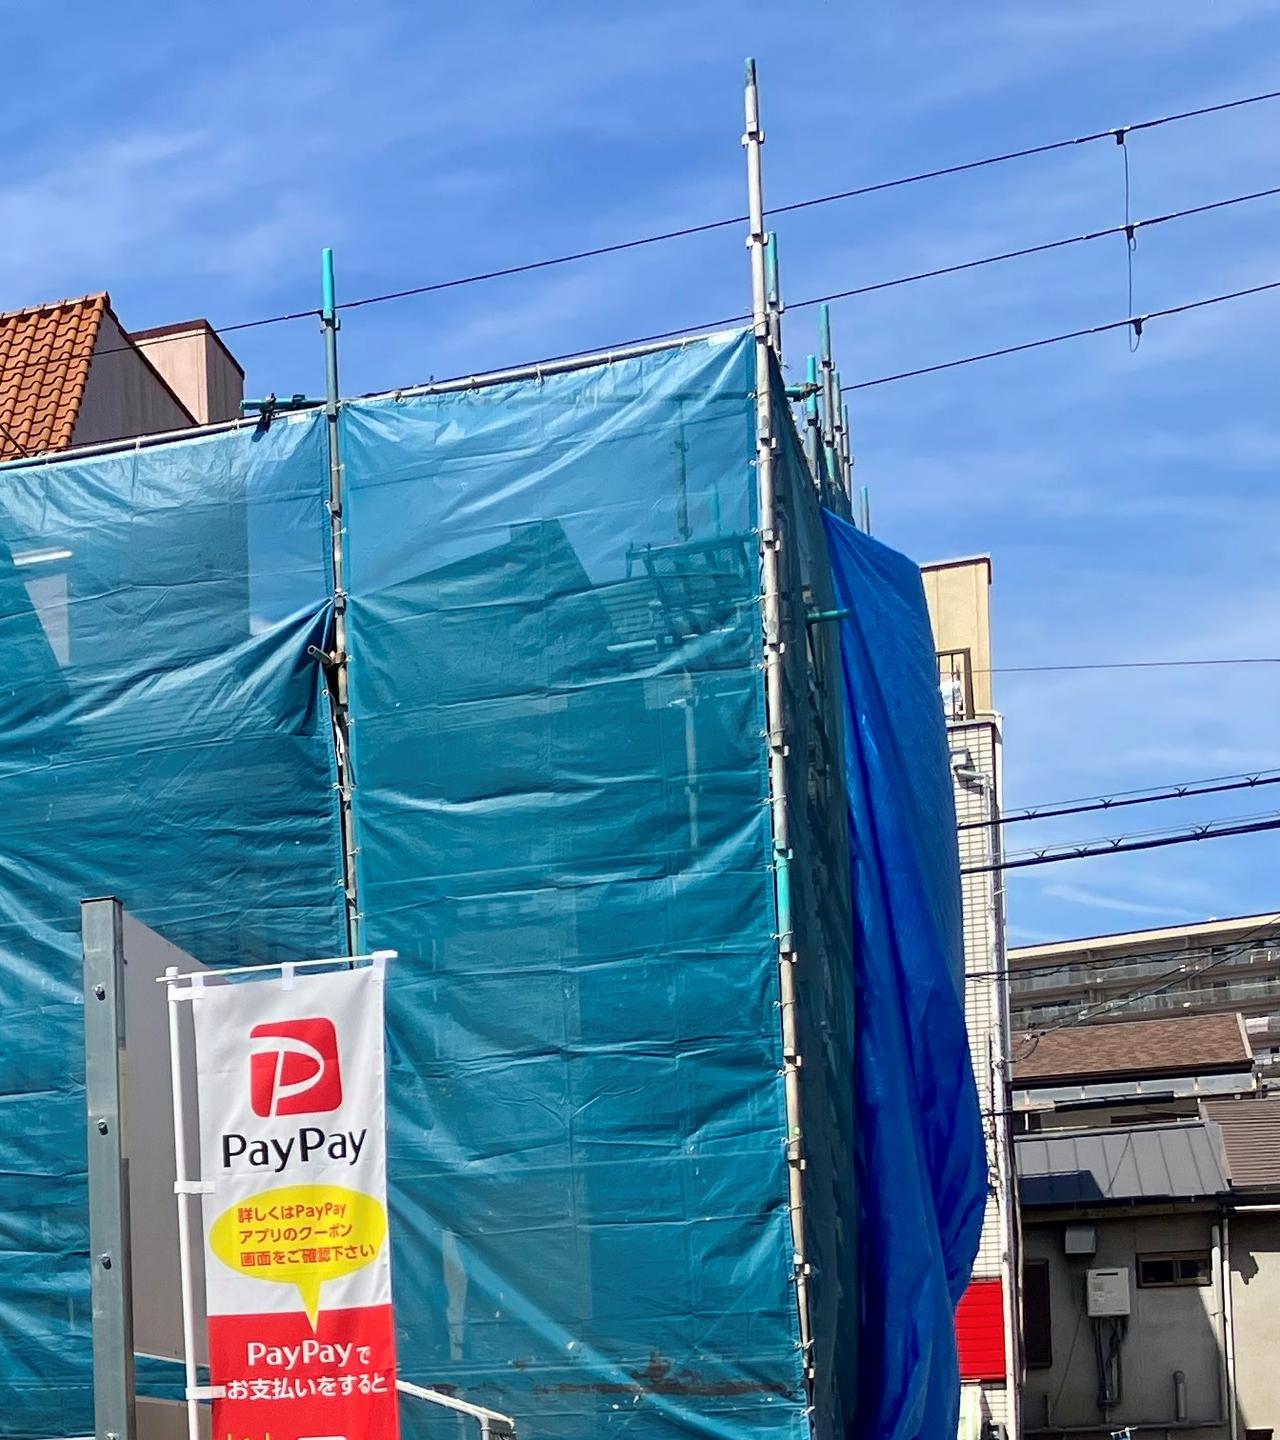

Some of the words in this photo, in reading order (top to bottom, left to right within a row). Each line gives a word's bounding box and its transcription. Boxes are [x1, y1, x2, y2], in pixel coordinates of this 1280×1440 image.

[223, 1127, 368, 1173] PayPay
[237, 1201, 346, 1224] 詳しくはPayPay
[239, 1224, 353, 1245] アプリのクーポン
[240, 1243, 375, 1267] 画面をご確認下さい
[226, 1373, 388, 1401] お支払いをすると
